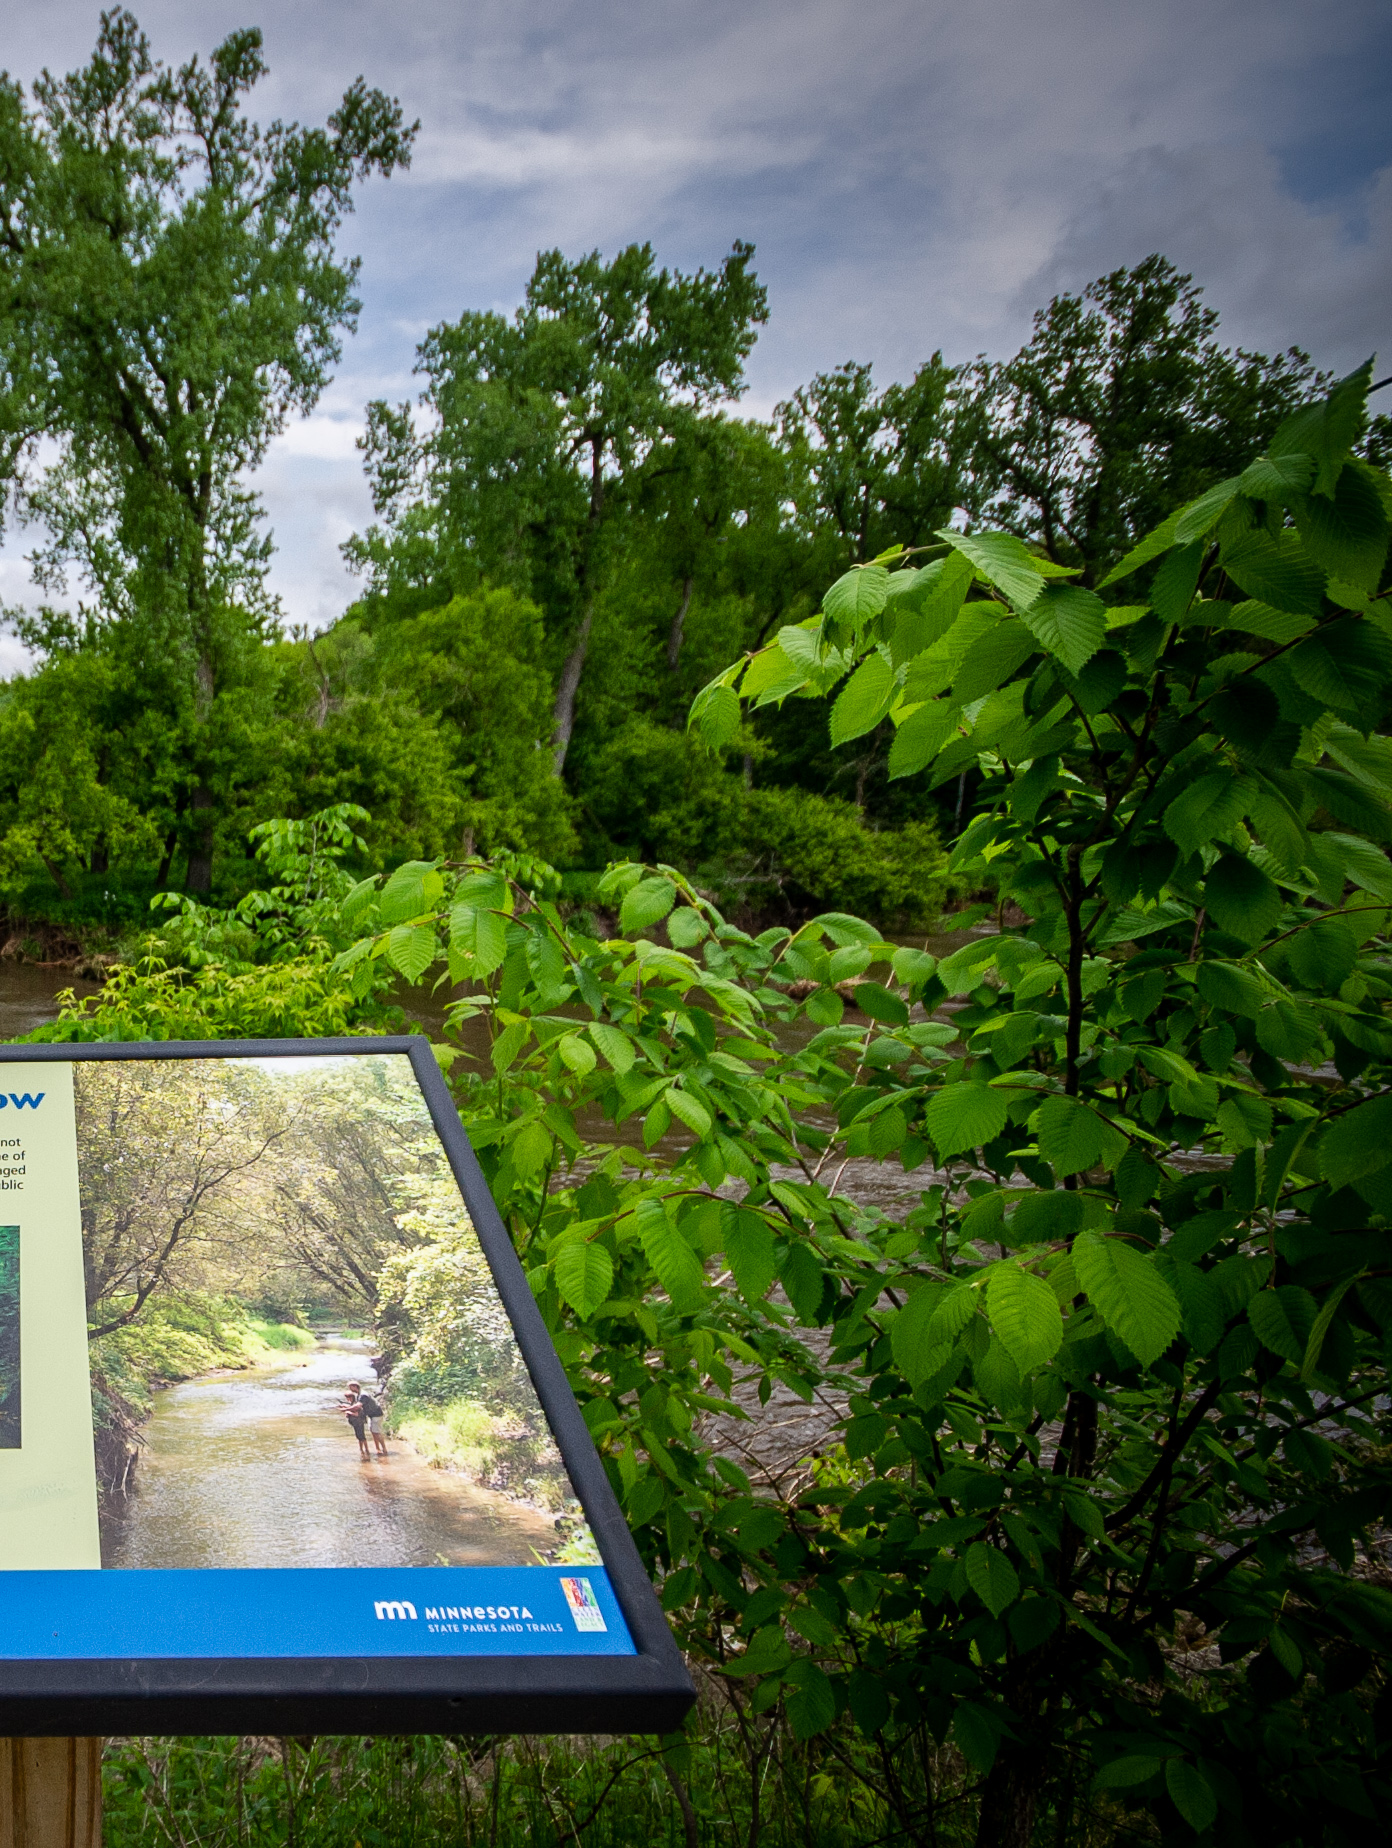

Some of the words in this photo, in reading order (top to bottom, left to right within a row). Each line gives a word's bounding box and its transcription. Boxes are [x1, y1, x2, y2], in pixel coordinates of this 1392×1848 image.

[0, 1138, 21, 1147] not
[12, 1150, 26, 1161] of
[427, 1623, 460, 1633] STATE
[462, 1623, 498, 1633] PARKS
[500, 1623, 524, 1633] AND
[525, 1623, 564, 1633] TRAILS
